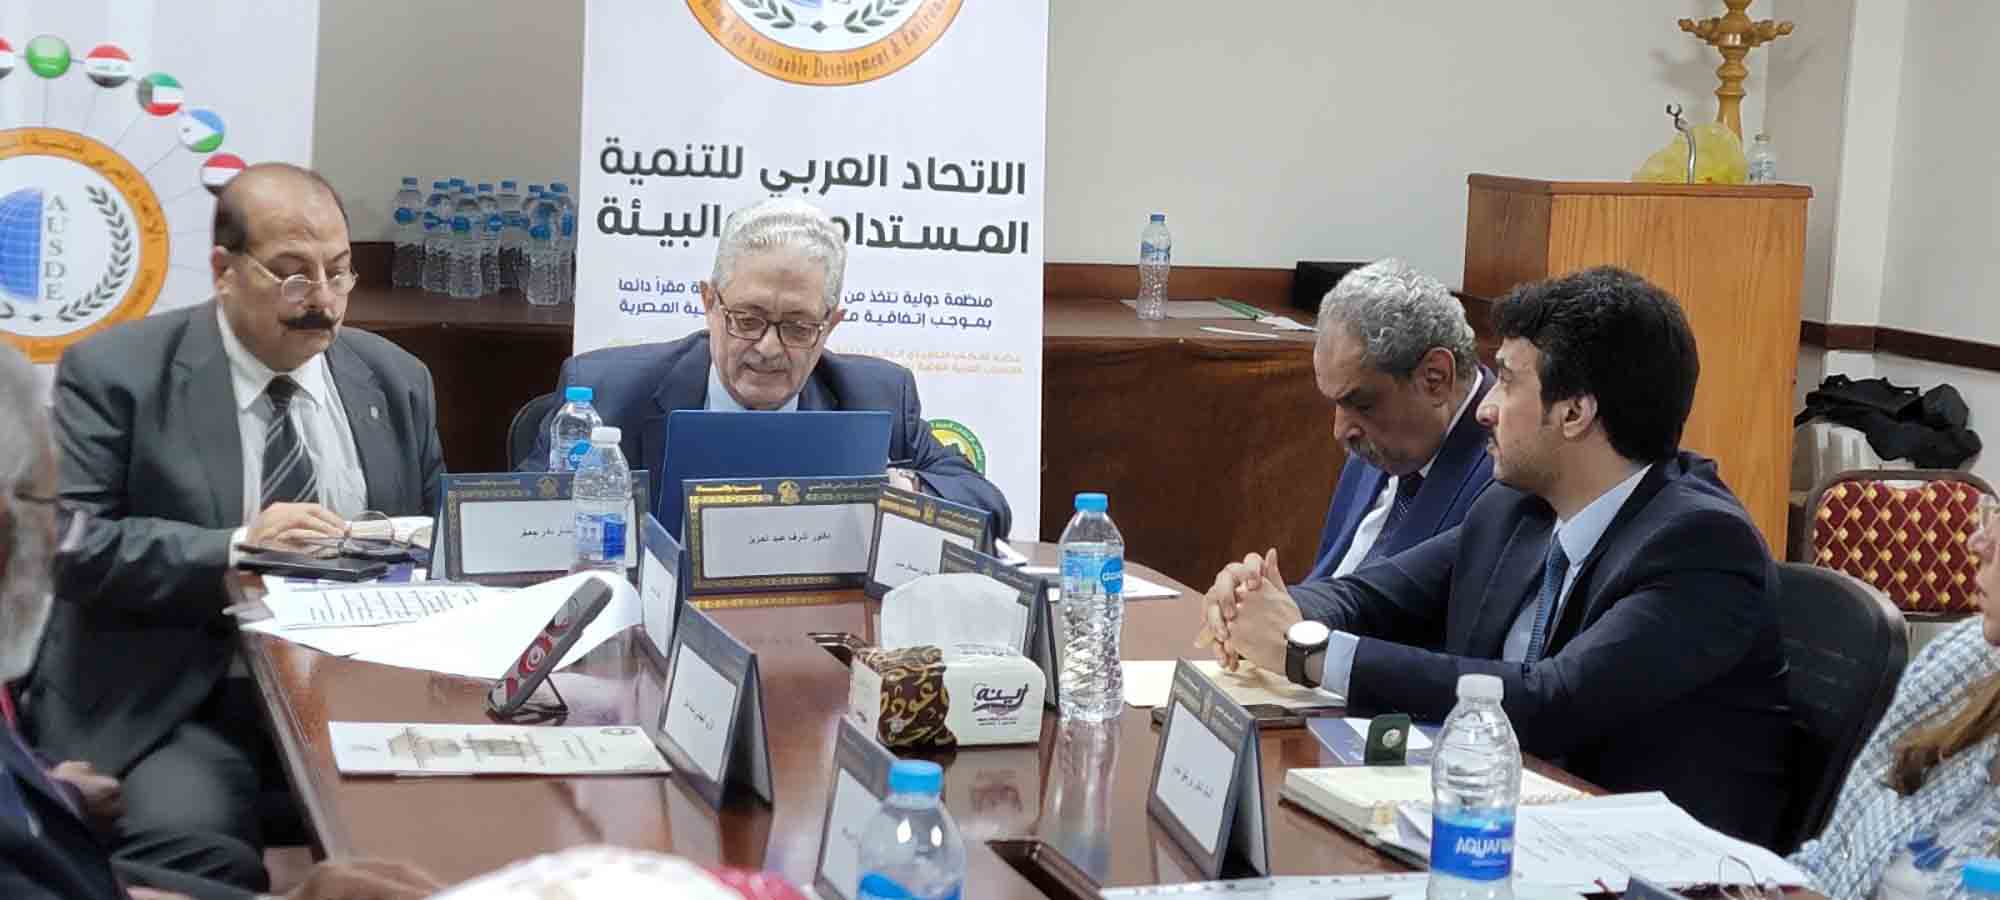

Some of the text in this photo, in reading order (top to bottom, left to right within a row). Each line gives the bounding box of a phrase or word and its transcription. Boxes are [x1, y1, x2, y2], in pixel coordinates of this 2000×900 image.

[815, 48, 890, 80] Development
[600, 137, 1027, 198] الاتحاد العربي للتنمية
[597, 196, 1029, 254] المستدا البيئة
[844, 289, 866, 305] من
[903, 291, 940, 308] دولية
[943, 291, 993, 309] منظمة
[619, 299, 679, 316] المصرية
[930, 313, 993, 331] بموجب
